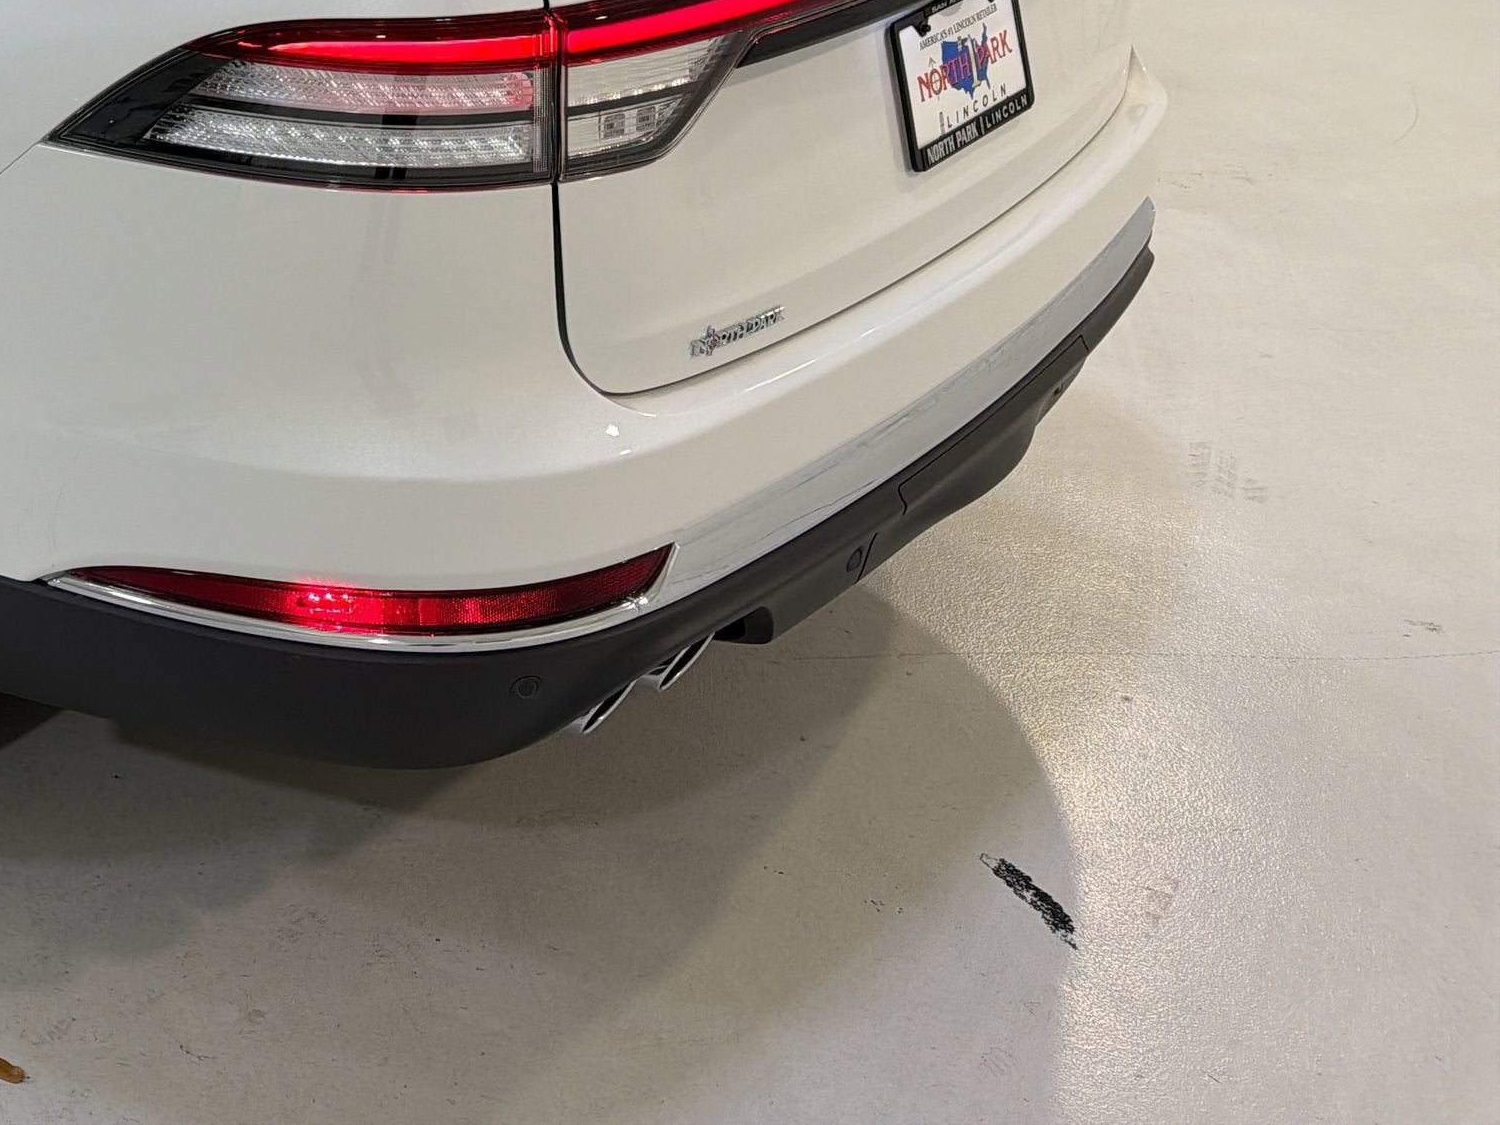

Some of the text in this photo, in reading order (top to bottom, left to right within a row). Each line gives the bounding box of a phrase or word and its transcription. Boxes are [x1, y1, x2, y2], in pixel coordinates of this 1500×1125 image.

[952, 17, 977, 34] LINCOLN
[916, 29, 1013, 103] NORTH PARK
[926, 94, 1029, 165] NORTH PARK LINCOLN
[946, 82, 1007, 129] LINCOLN
